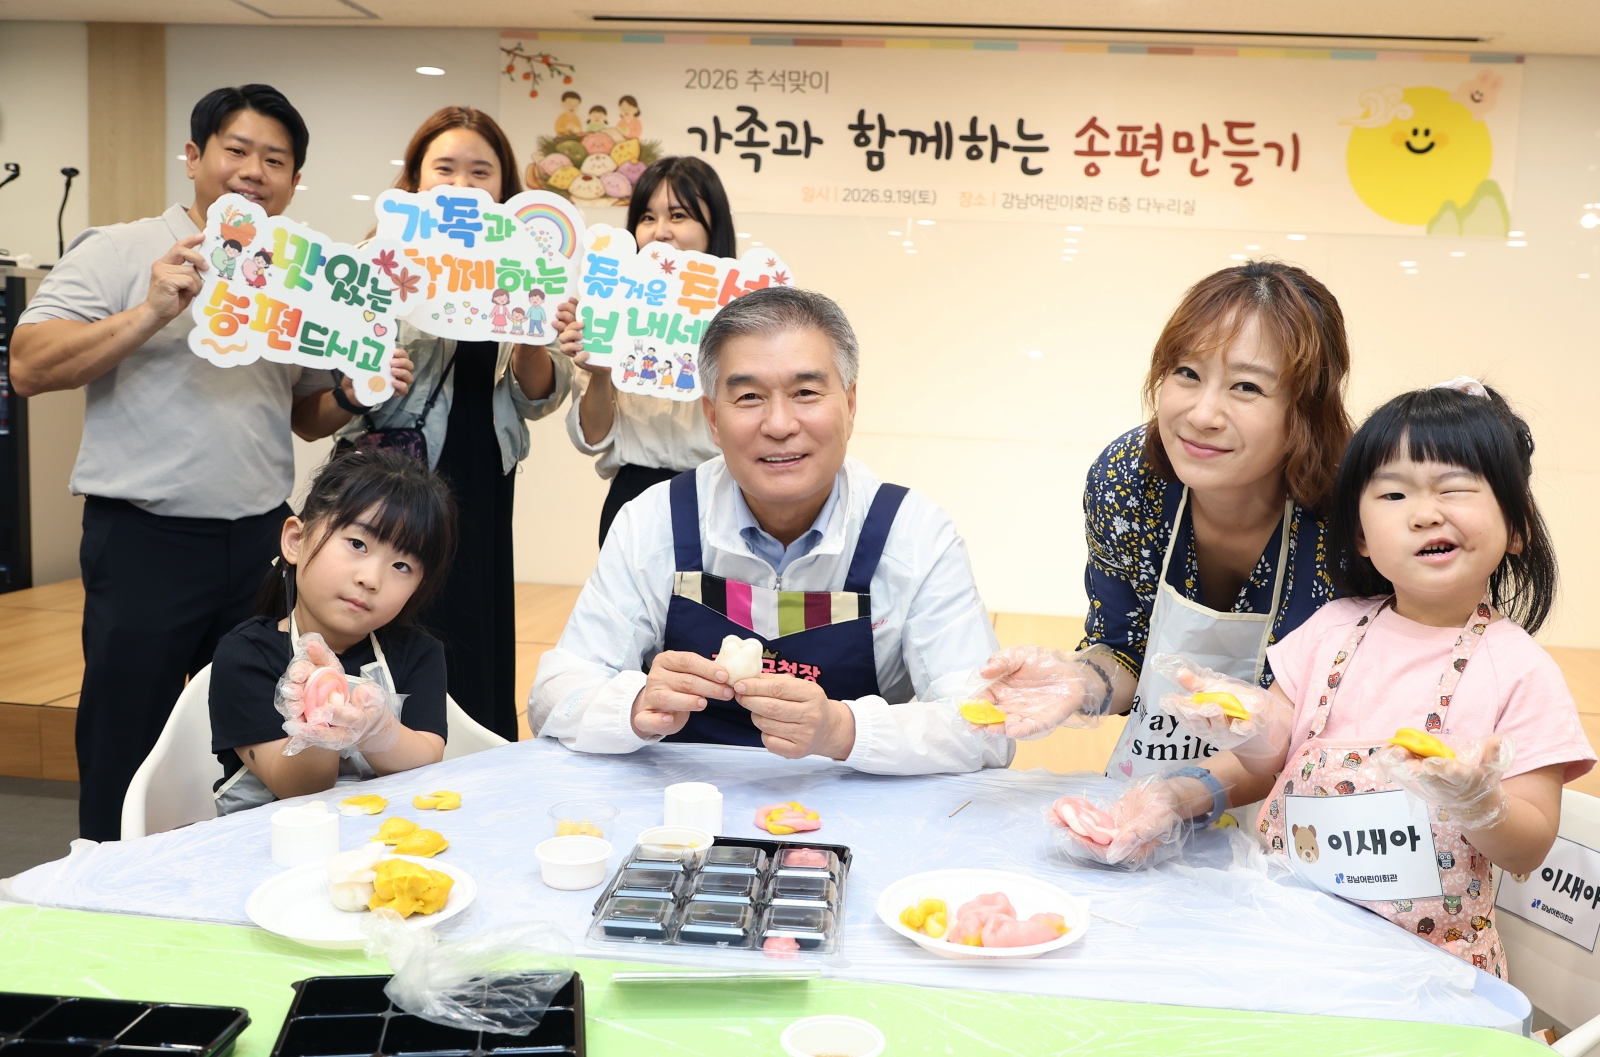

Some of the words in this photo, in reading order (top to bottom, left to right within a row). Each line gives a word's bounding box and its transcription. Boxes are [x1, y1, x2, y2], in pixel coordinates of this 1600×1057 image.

[684, 67, 739, 90] 2026
[744, 68, 830, 94] 추석맞이
[687, 105, 824, 173] 가족과
[847, 108, 1050, 176] 함께하는
[1073, 116, 1302, 187] 송편만들기
[383, 195, 516, 248] 가족과
[800, 186, 830, 203] 일시
[841, 187, 938, 206] 2026.9.19(토)
[958, 190, 988, 208] 장소
[1001, 192, 1103, 213] 강남어린이회관
[1107, 196, 1133, 214] 6층
[1137, 197, 1197, 216] 다누리실
[271, 227, 393, 313] 맛있는
[583, 253, 668, 306] 즐거운
[203, 281, 303, 351] 송편
[298, 320, 386, 372] 드시고
[1131, 735, 1219, 761] smile
[1327, 825, 1421, 857] 이새아
[1345, 873, 1398, 884] 강남어린이회관
[1541, 867, 1600, 910] 이새아
